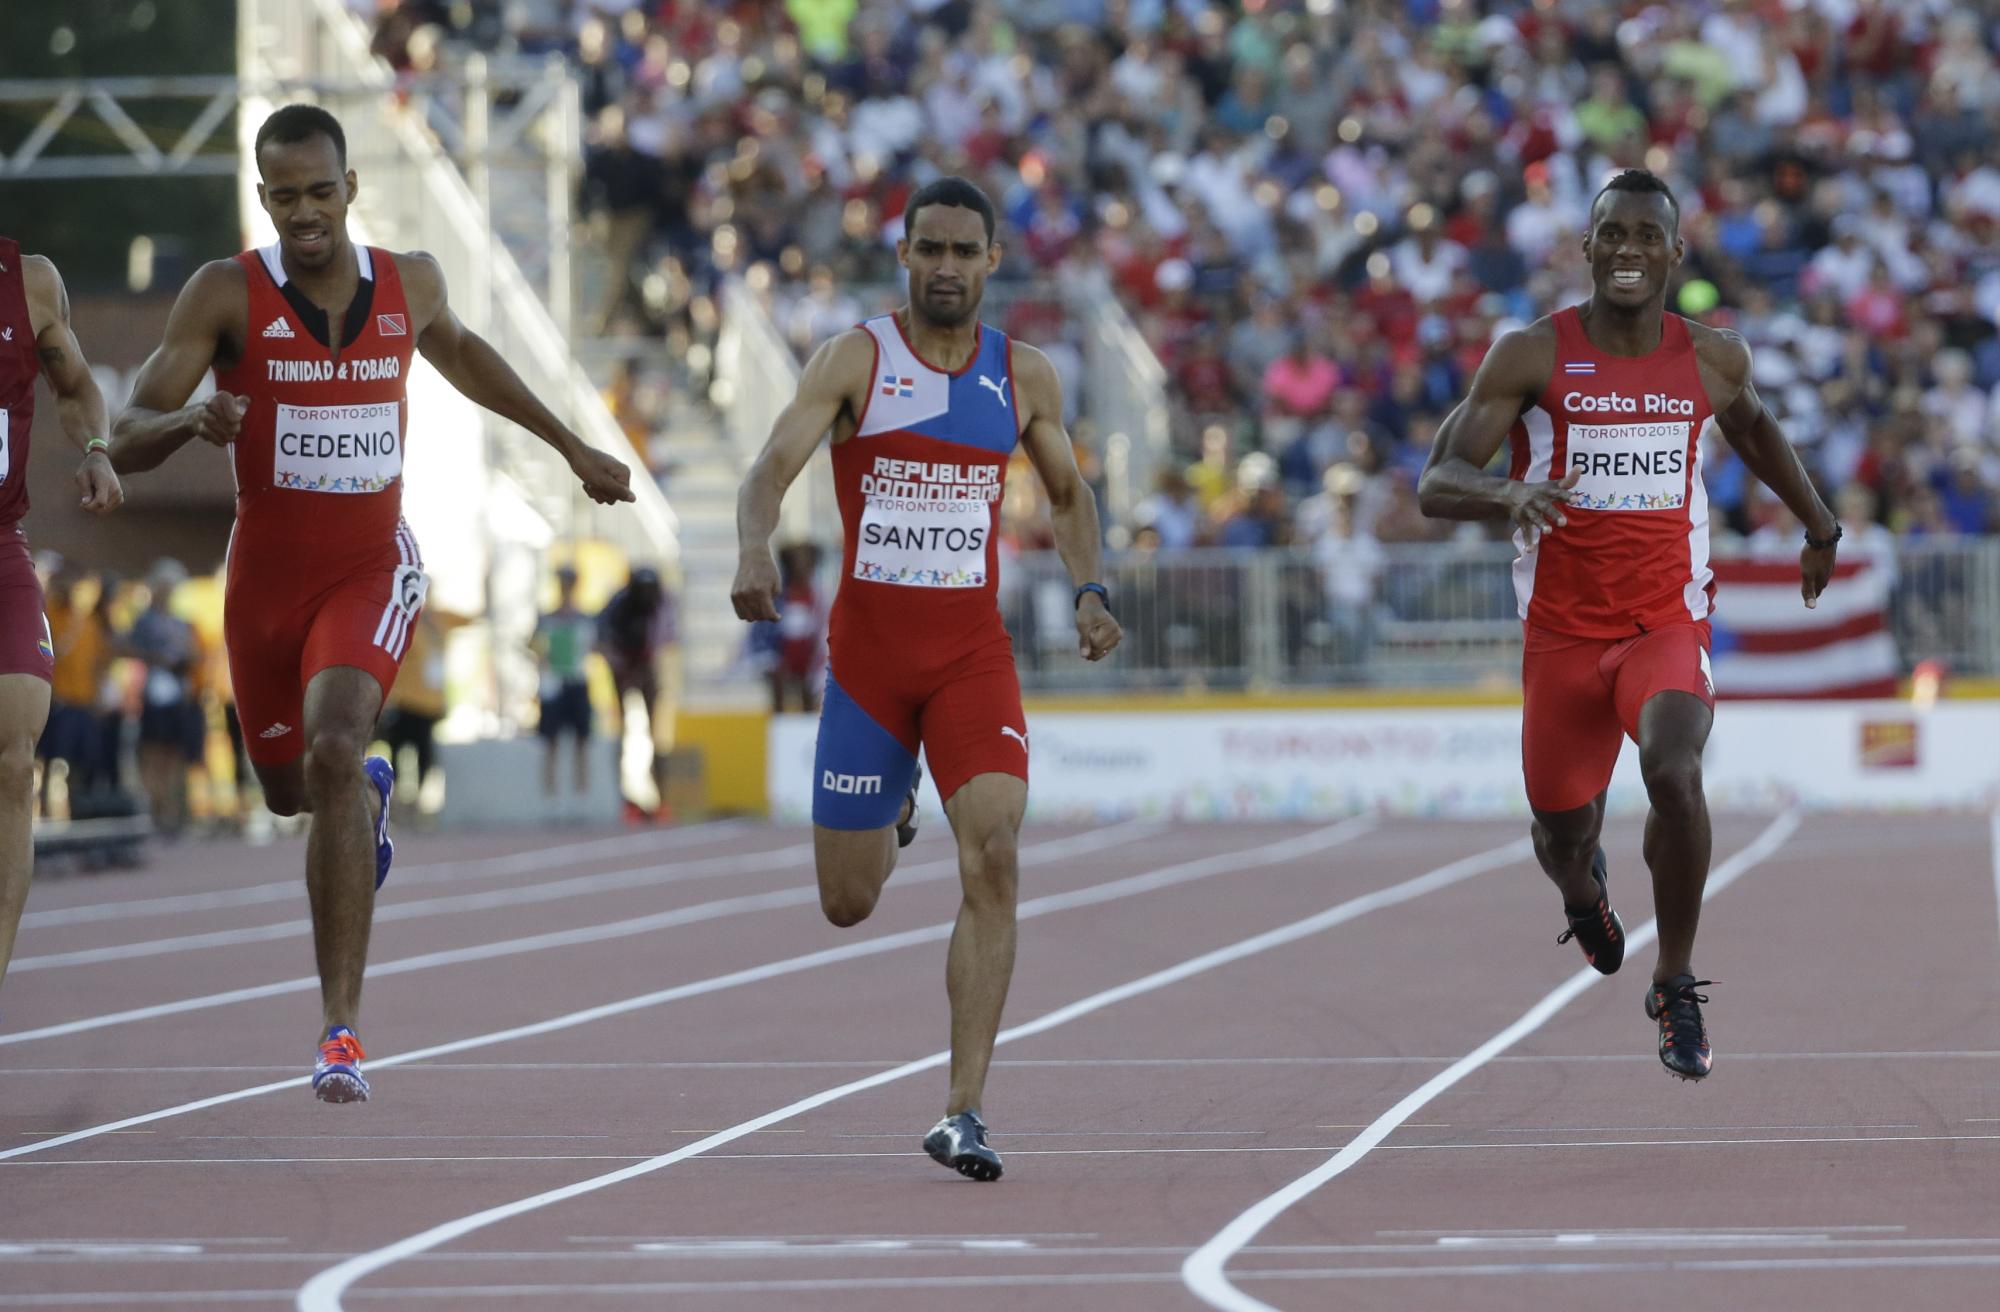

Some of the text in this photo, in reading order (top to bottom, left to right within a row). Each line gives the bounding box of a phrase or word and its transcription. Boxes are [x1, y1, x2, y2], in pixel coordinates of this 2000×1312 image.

[262, 329, 295, 338] adidas
[267, 356, 400, 381] TRINIDAD & TOBAGO
[1563, 391, 1694, 415] Costa Rica
[280, 431, 395, 458] CEDENIO
[873, 456, 999, 483] REPUBLICA
[1572, 449, 1682, 477] BRENES
[860, 473, 1001, 502] DOMINICANA
[864, 523, 984, 552] SANTOS
[822, 769, 882, 794] DOM
